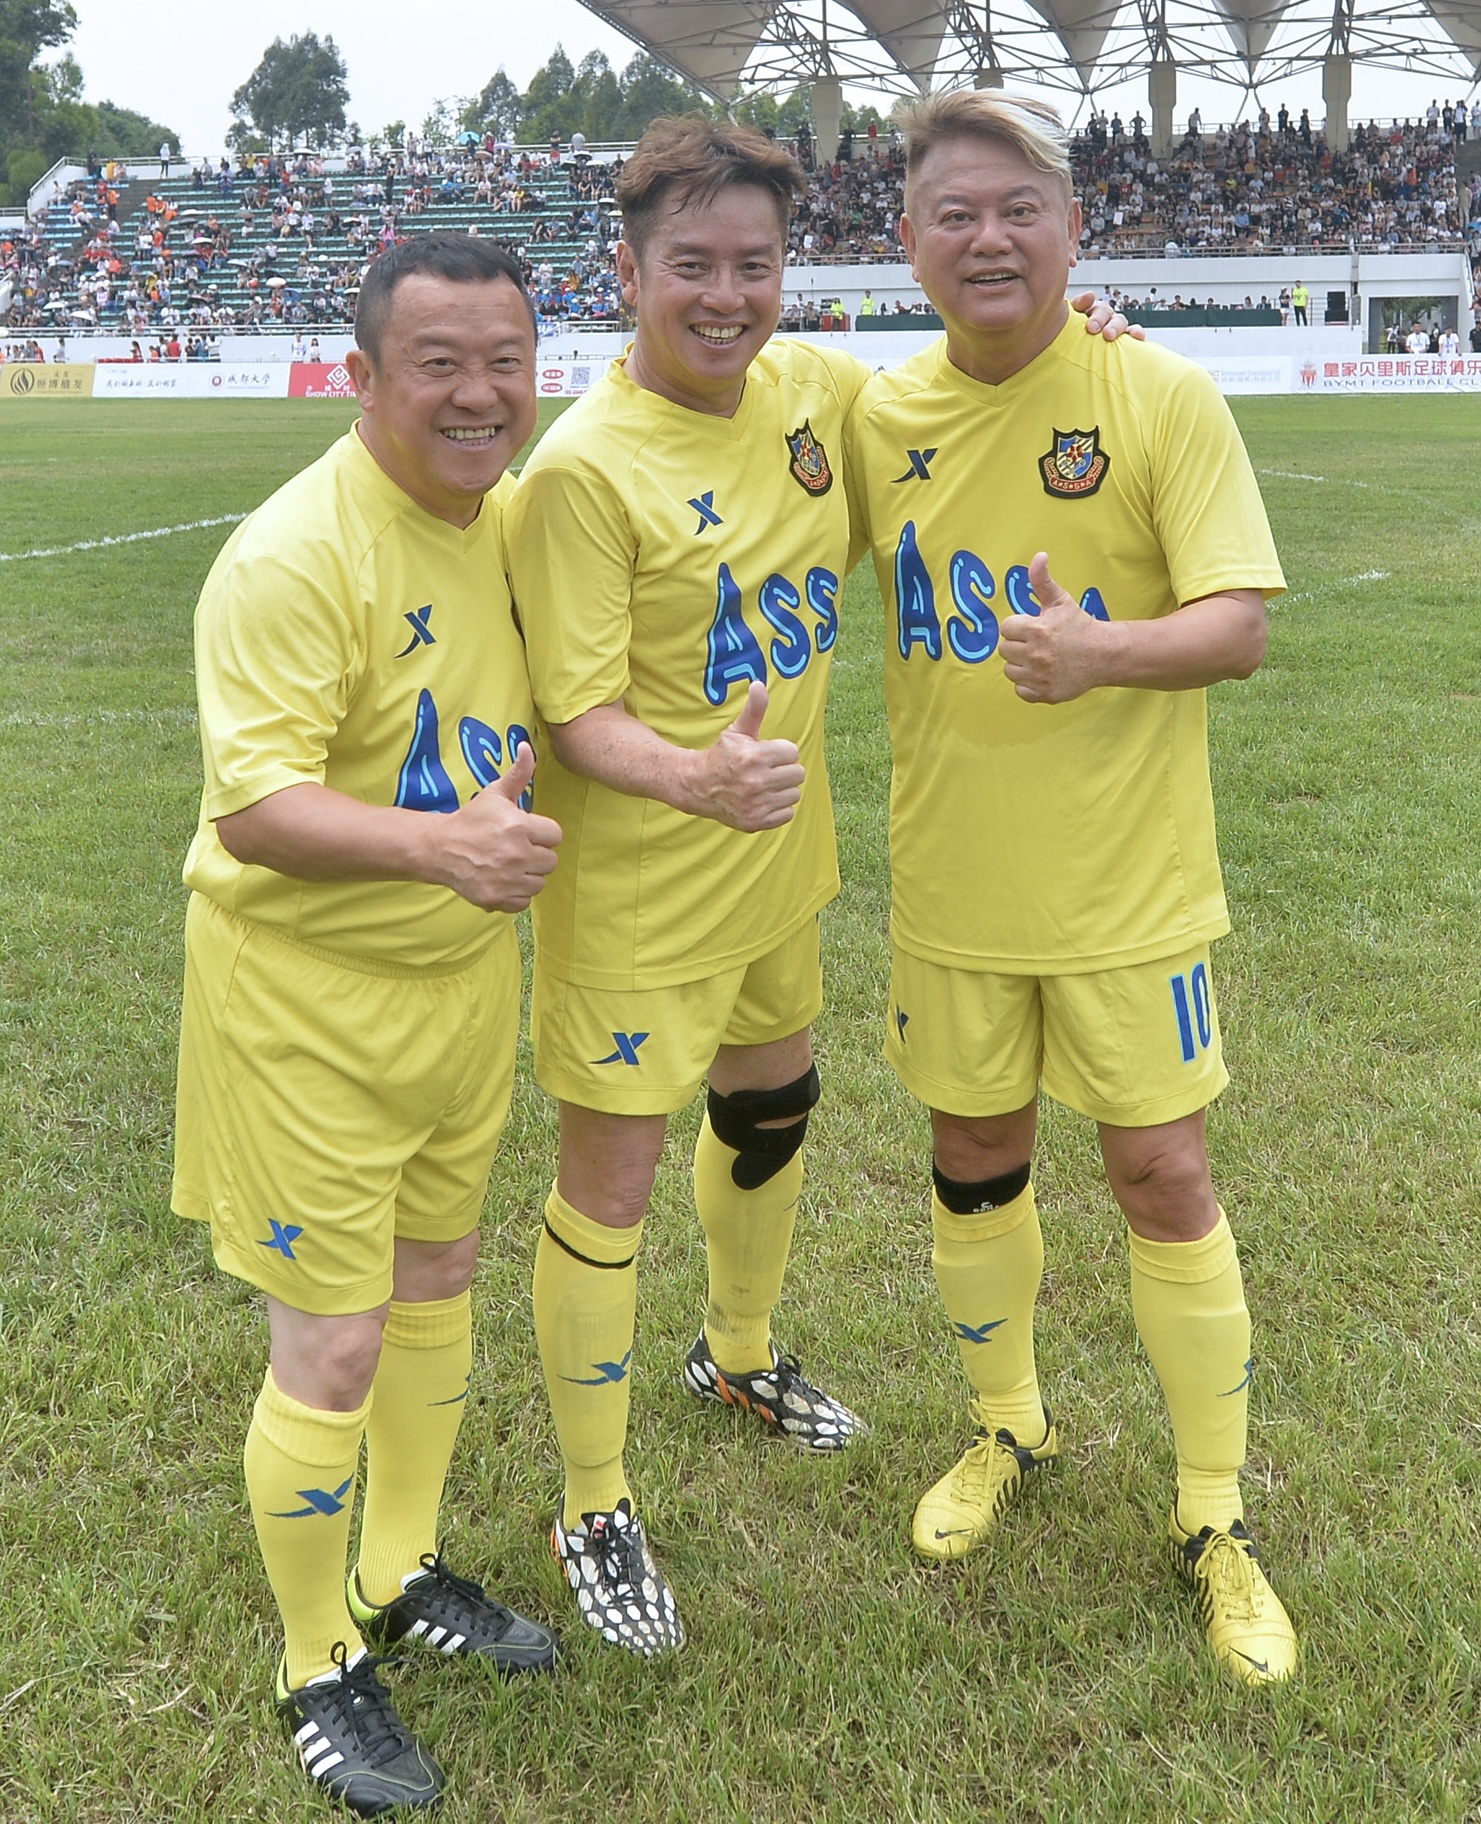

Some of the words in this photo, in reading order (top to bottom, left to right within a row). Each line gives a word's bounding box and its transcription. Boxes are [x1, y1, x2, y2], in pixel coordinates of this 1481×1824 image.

[1324, 360, 1481, 378] 皇家贝里斯足球俱乐
[1324, 379, 1365, 387] BYMT
[1372, 378, 1454, 387] FOOTBALL
[895, 519, 1111, 664] AS
[1168, 961, 1212, 1064] 10
